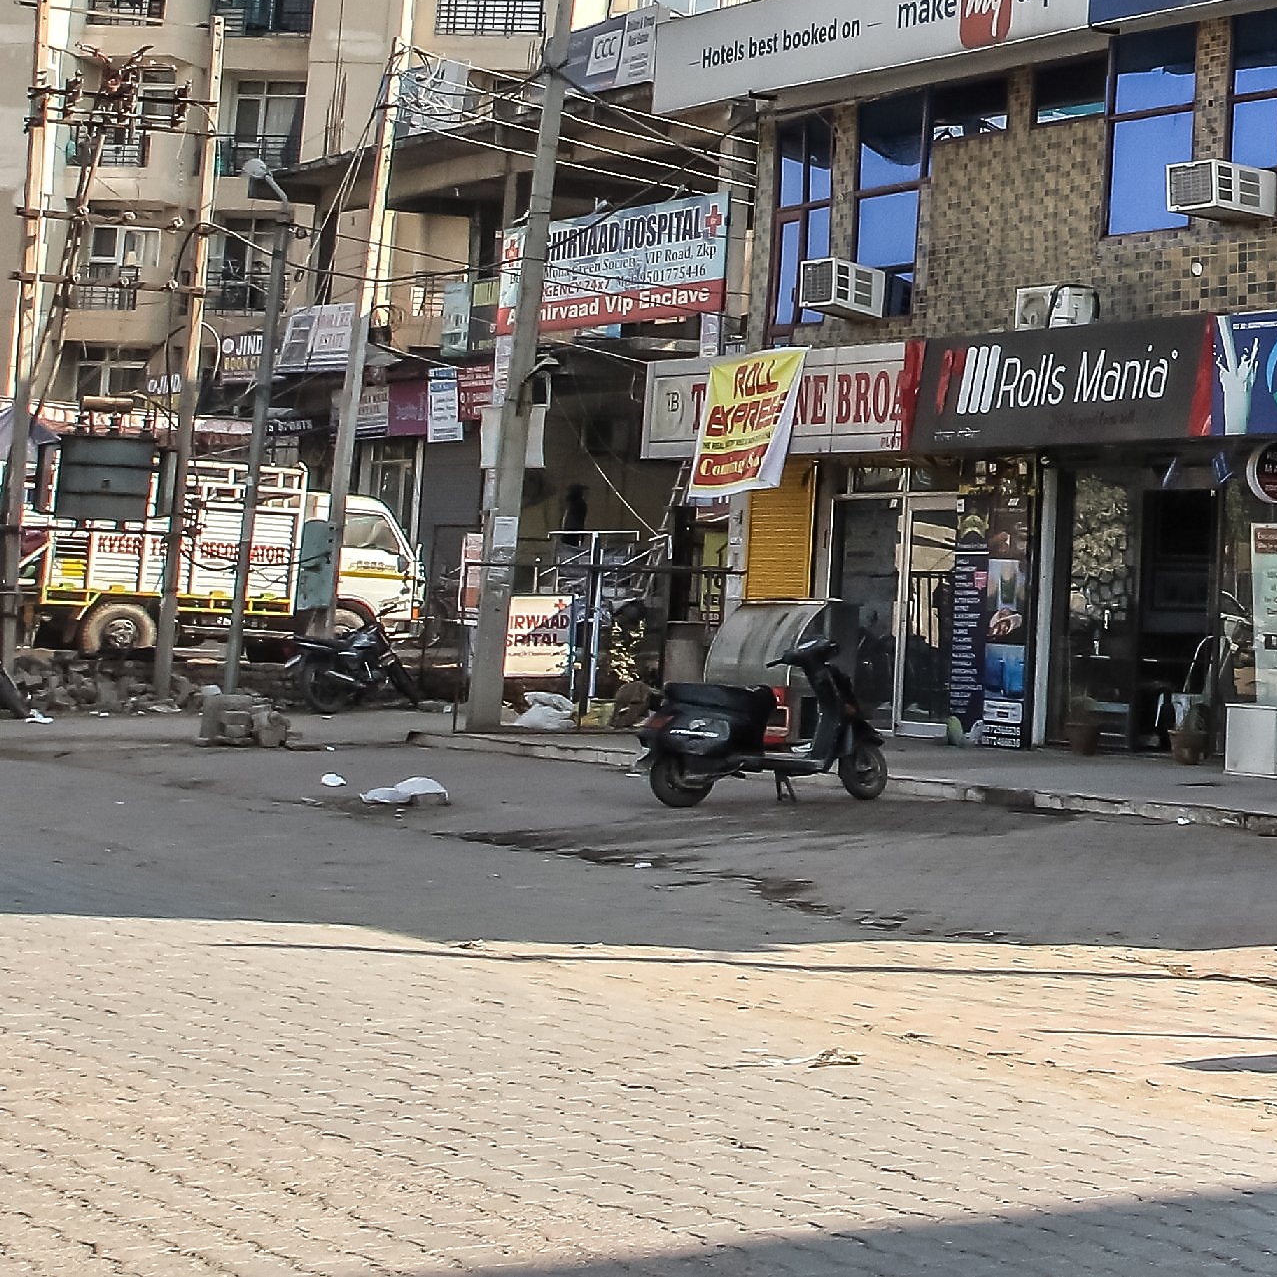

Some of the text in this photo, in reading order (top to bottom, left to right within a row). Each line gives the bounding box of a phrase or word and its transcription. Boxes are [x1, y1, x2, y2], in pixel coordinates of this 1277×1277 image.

[595, 37, 617, 59] CCC
[702, 17, 861, 69] Hotels best booked on
[622, 205, 703, 251] HOSPITAL
[605, 296, 633, 316] Vip
[639, 286, 710, 309] Enclave
[733, 359, 779, 399] ROLL
[996, 344, 1170, 410] Rolls Mania
[509, 614, 571, 630] IRWAAD
[505, 633, 564, 647] SPITAL
